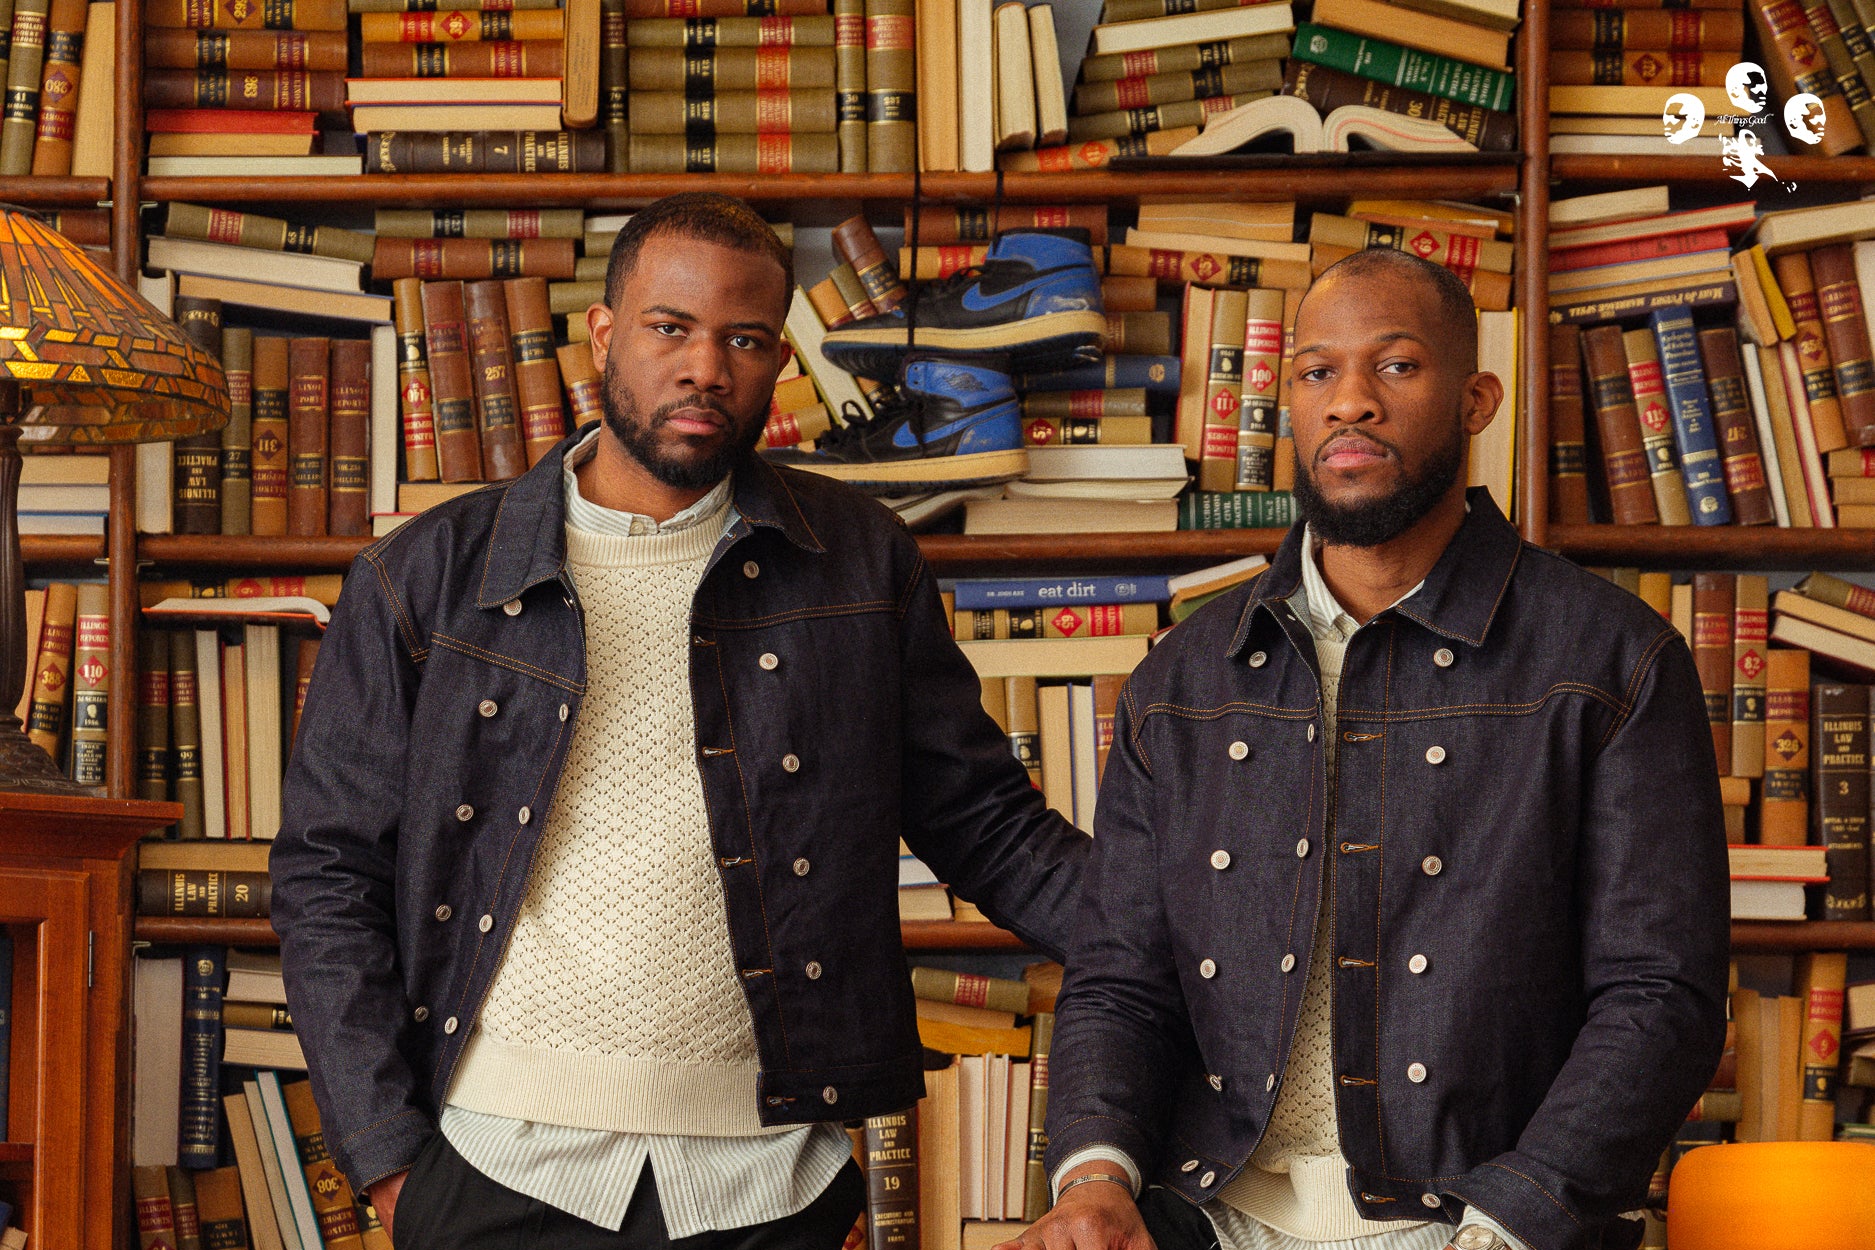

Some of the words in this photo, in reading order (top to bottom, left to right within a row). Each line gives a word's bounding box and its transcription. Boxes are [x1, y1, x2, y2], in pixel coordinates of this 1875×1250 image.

[1406, 101, 1424, 118] 30
[494, 145, 508, 155] 7
[546, 142, 557, 159] LAW
[485, 365, 507, 381] 257
[1250, 367, 1273, 383] 100
[257, 438, 278, 452] 311
[188, 476, 207, 487] LAW
[1223, 500, 1232, 522] CIVIL
[1038, 583, 1063, 598] eat
[1066, 581, 1096, 598] dirt
[82, 663, 104, 681] 110
[1744, 657, 1761, 672] 82
[40, 670, 62, 685] 388
[1823, 721, 1863, 732] ILLINOIS
[1777, 739, 1799, 753] 326
[1834, 733, 1853, 744] LAW
[1839, 781, 1849, 796] 3
[174, 873, 185, 911] ILLINOIS
[187, 883, 196, 901] LAW
[207, 872, 218, 912] PRACTICE
[235, 884, 249, 903] 20
[867, 1116, 906, 1128] ILLINOIS
[879, 1128, 897, 1139] LAW
[869, 1148, 911, 1162] PRACTICE
[316, 1176, 339, 1193] 308
[883, 1176, 900, 1190] 19
